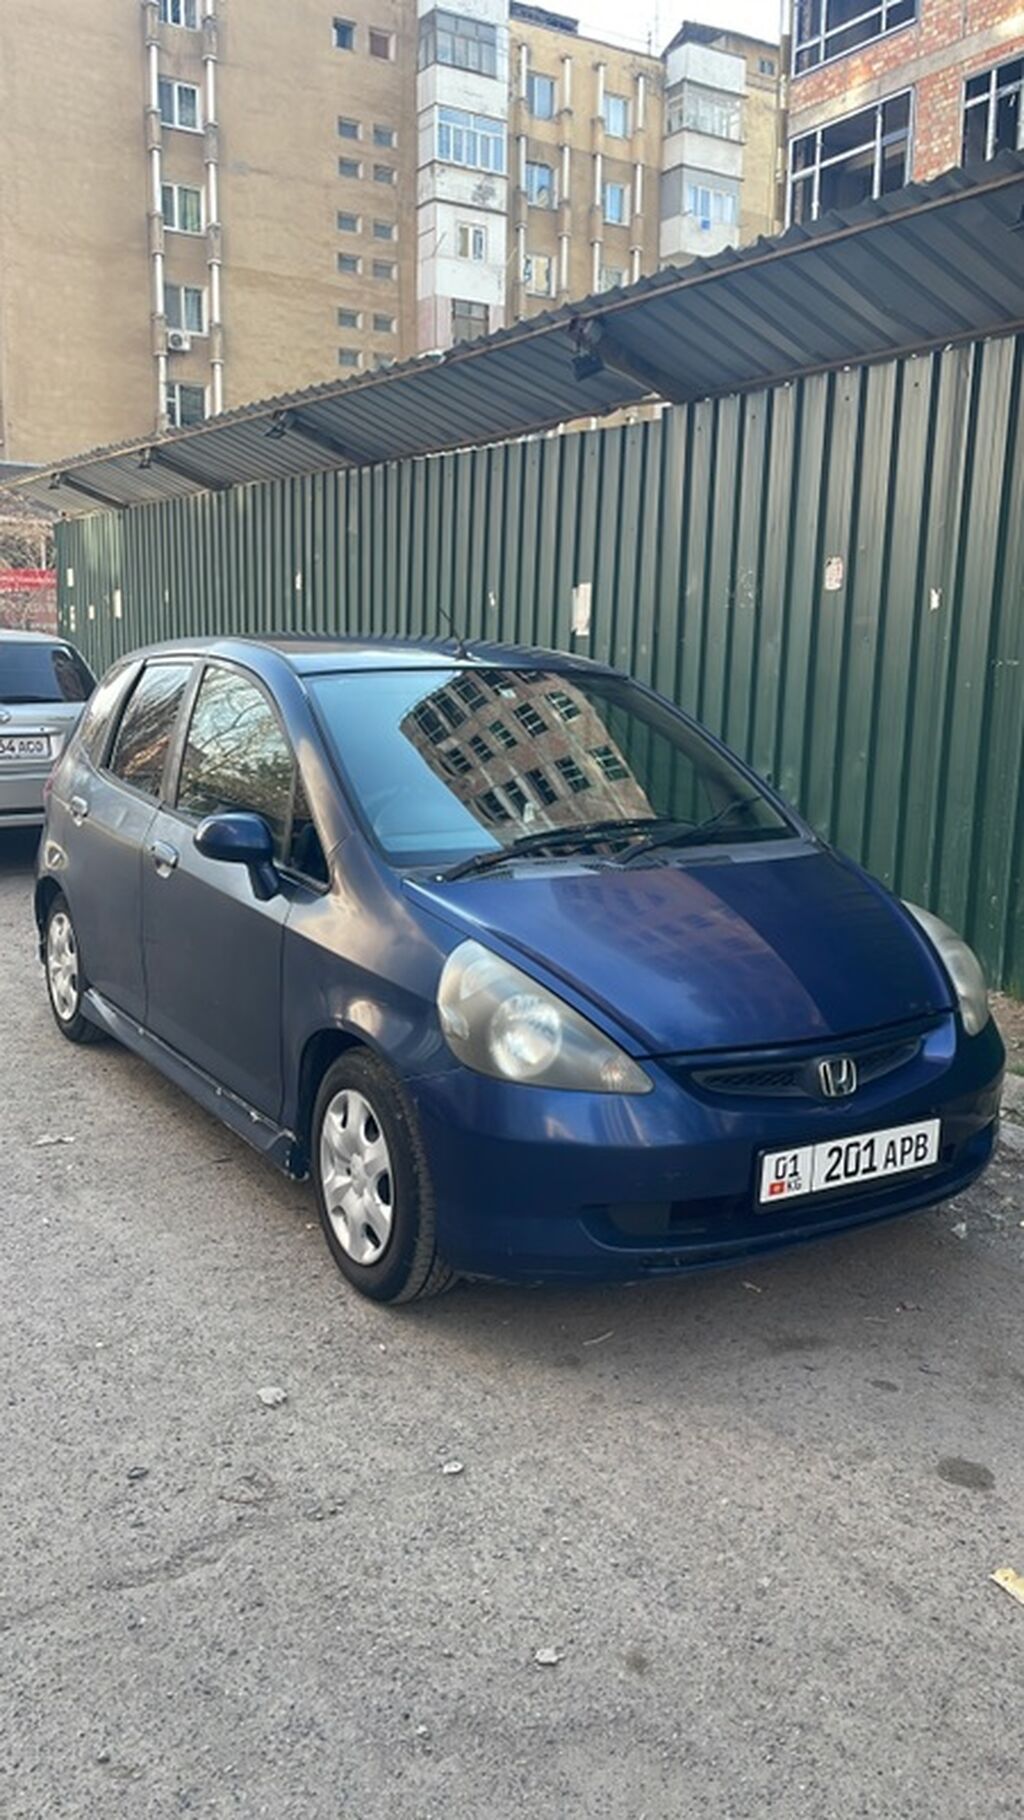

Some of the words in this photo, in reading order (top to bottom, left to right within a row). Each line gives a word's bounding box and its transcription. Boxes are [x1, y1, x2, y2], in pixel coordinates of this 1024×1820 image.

[775, 1154, 799, 1179] 01
[825, 1138, 877, 1182] 201
[884, 1133, 928, 1169] APB
[787, 1177, 802, 1191] KG
